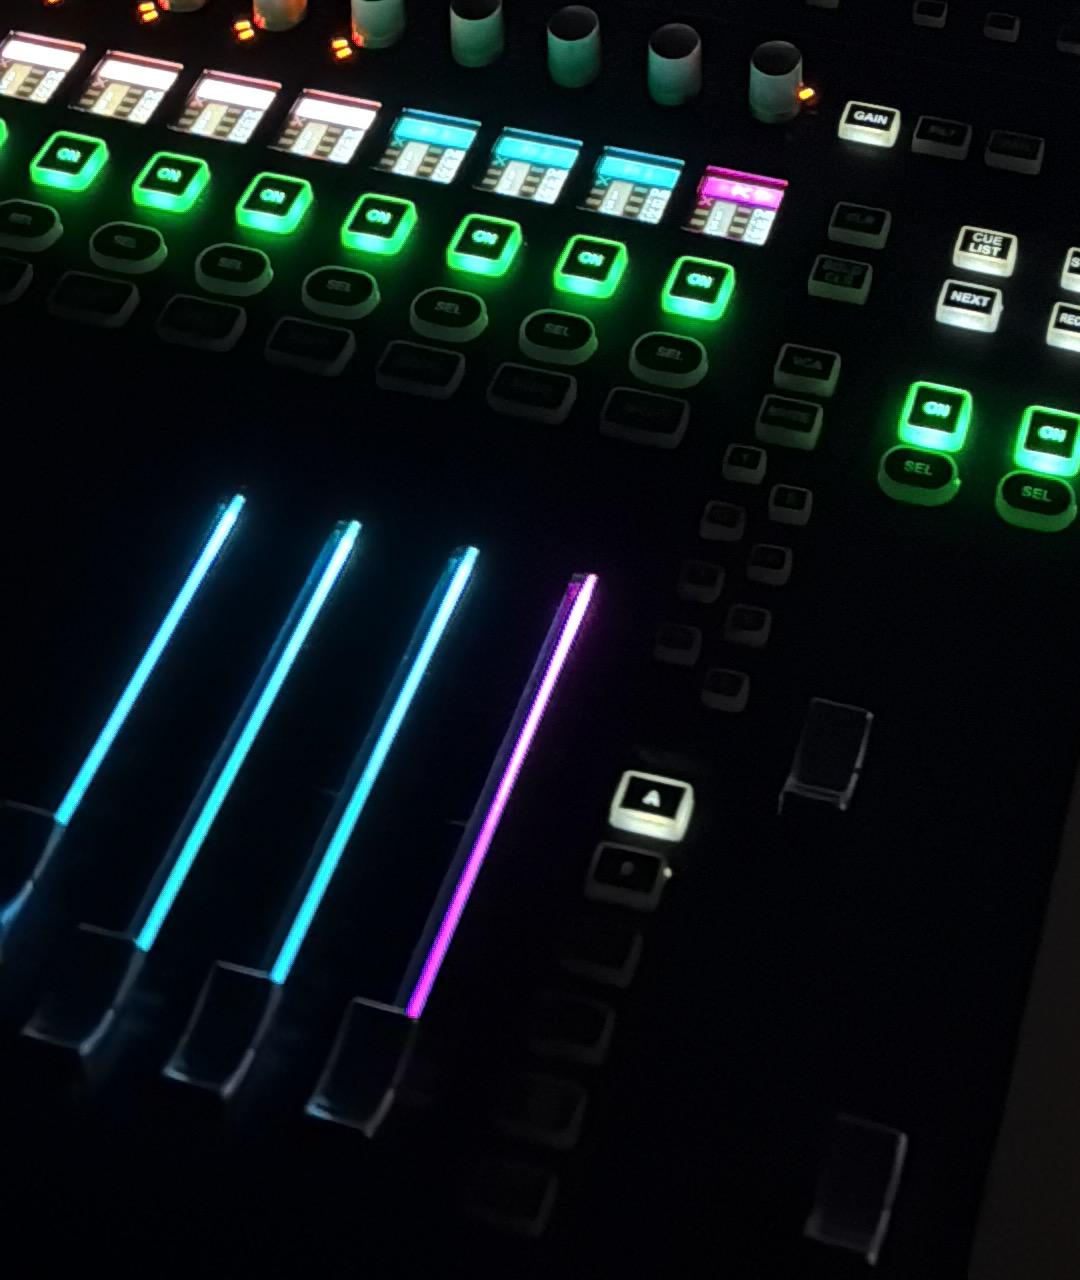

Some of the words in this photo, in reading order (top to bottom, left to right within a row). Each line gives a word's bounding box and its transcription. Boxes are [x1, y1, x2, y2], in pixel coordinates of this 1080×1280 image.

[853, 109, 888, 125] GAIN
[56, 147, 81, 163] ON
[157, 167, 182, 183] ON
[260, 188, 285, 204] ON
[366, 209, 392, 224] ON
[472, 229, 498, 245] ON
[972, 232, 1003, 247] CUE
[968, 244, 1002, 257] LIST
[578, 251, 604, 267] ON
[687, 272, 713, 288] ON
[950, 290, 991, 308] NEXT
[923, 401, 951, 419] ON
[1038, 425, 1066, 443] ON
[904, 459, 934, 477] SEL
[1022, 485, 1052, 503] SEL
